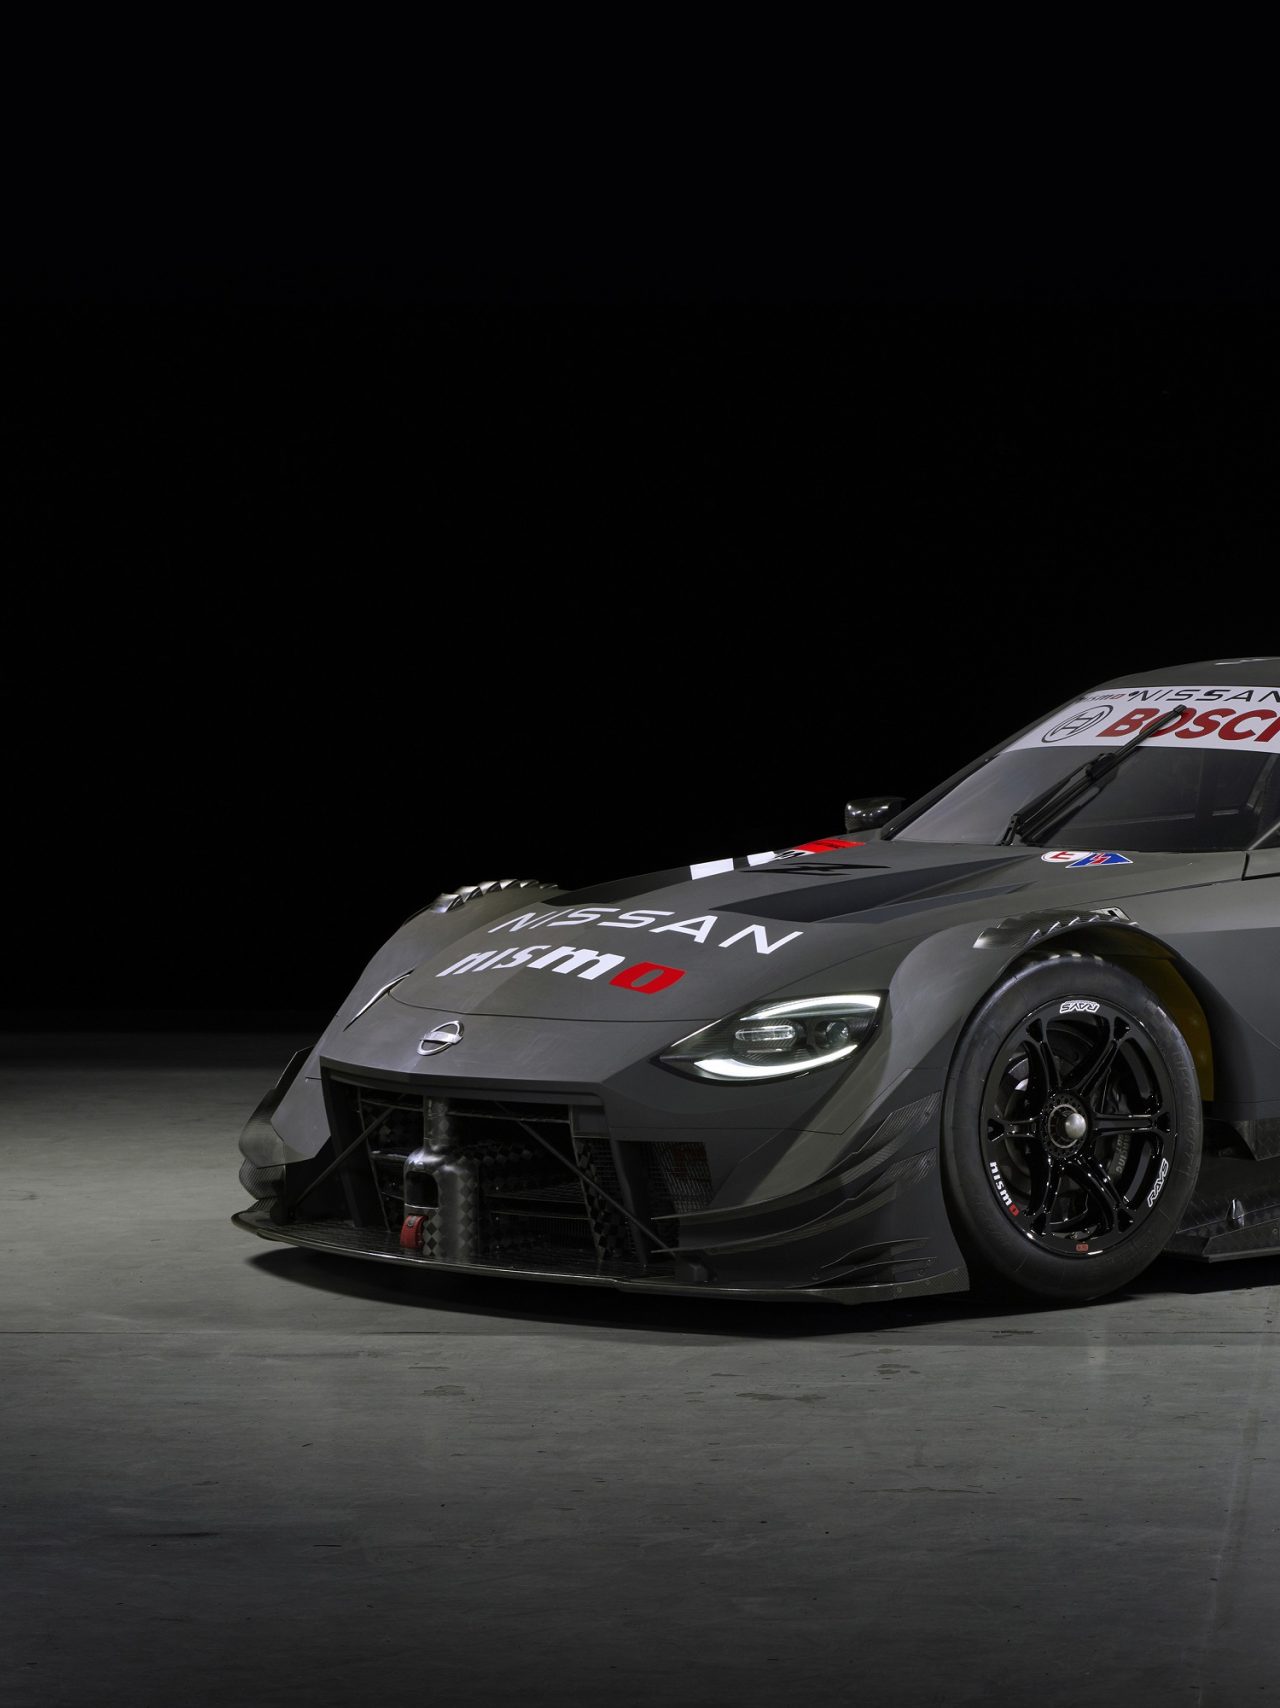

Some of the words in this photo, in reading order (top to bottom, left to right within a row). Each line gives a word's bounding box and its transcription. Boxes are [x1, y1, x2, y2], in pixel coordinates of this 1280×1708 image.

[489, 907, 803, 954] NISSAN
[436, 945, 686, 994] nismo
[1060, 1000, 1100, 1014] RAYS
[990, 1162, 1020, 1217] nismo
[1147, 1158, 1169, 1207] RAYS
